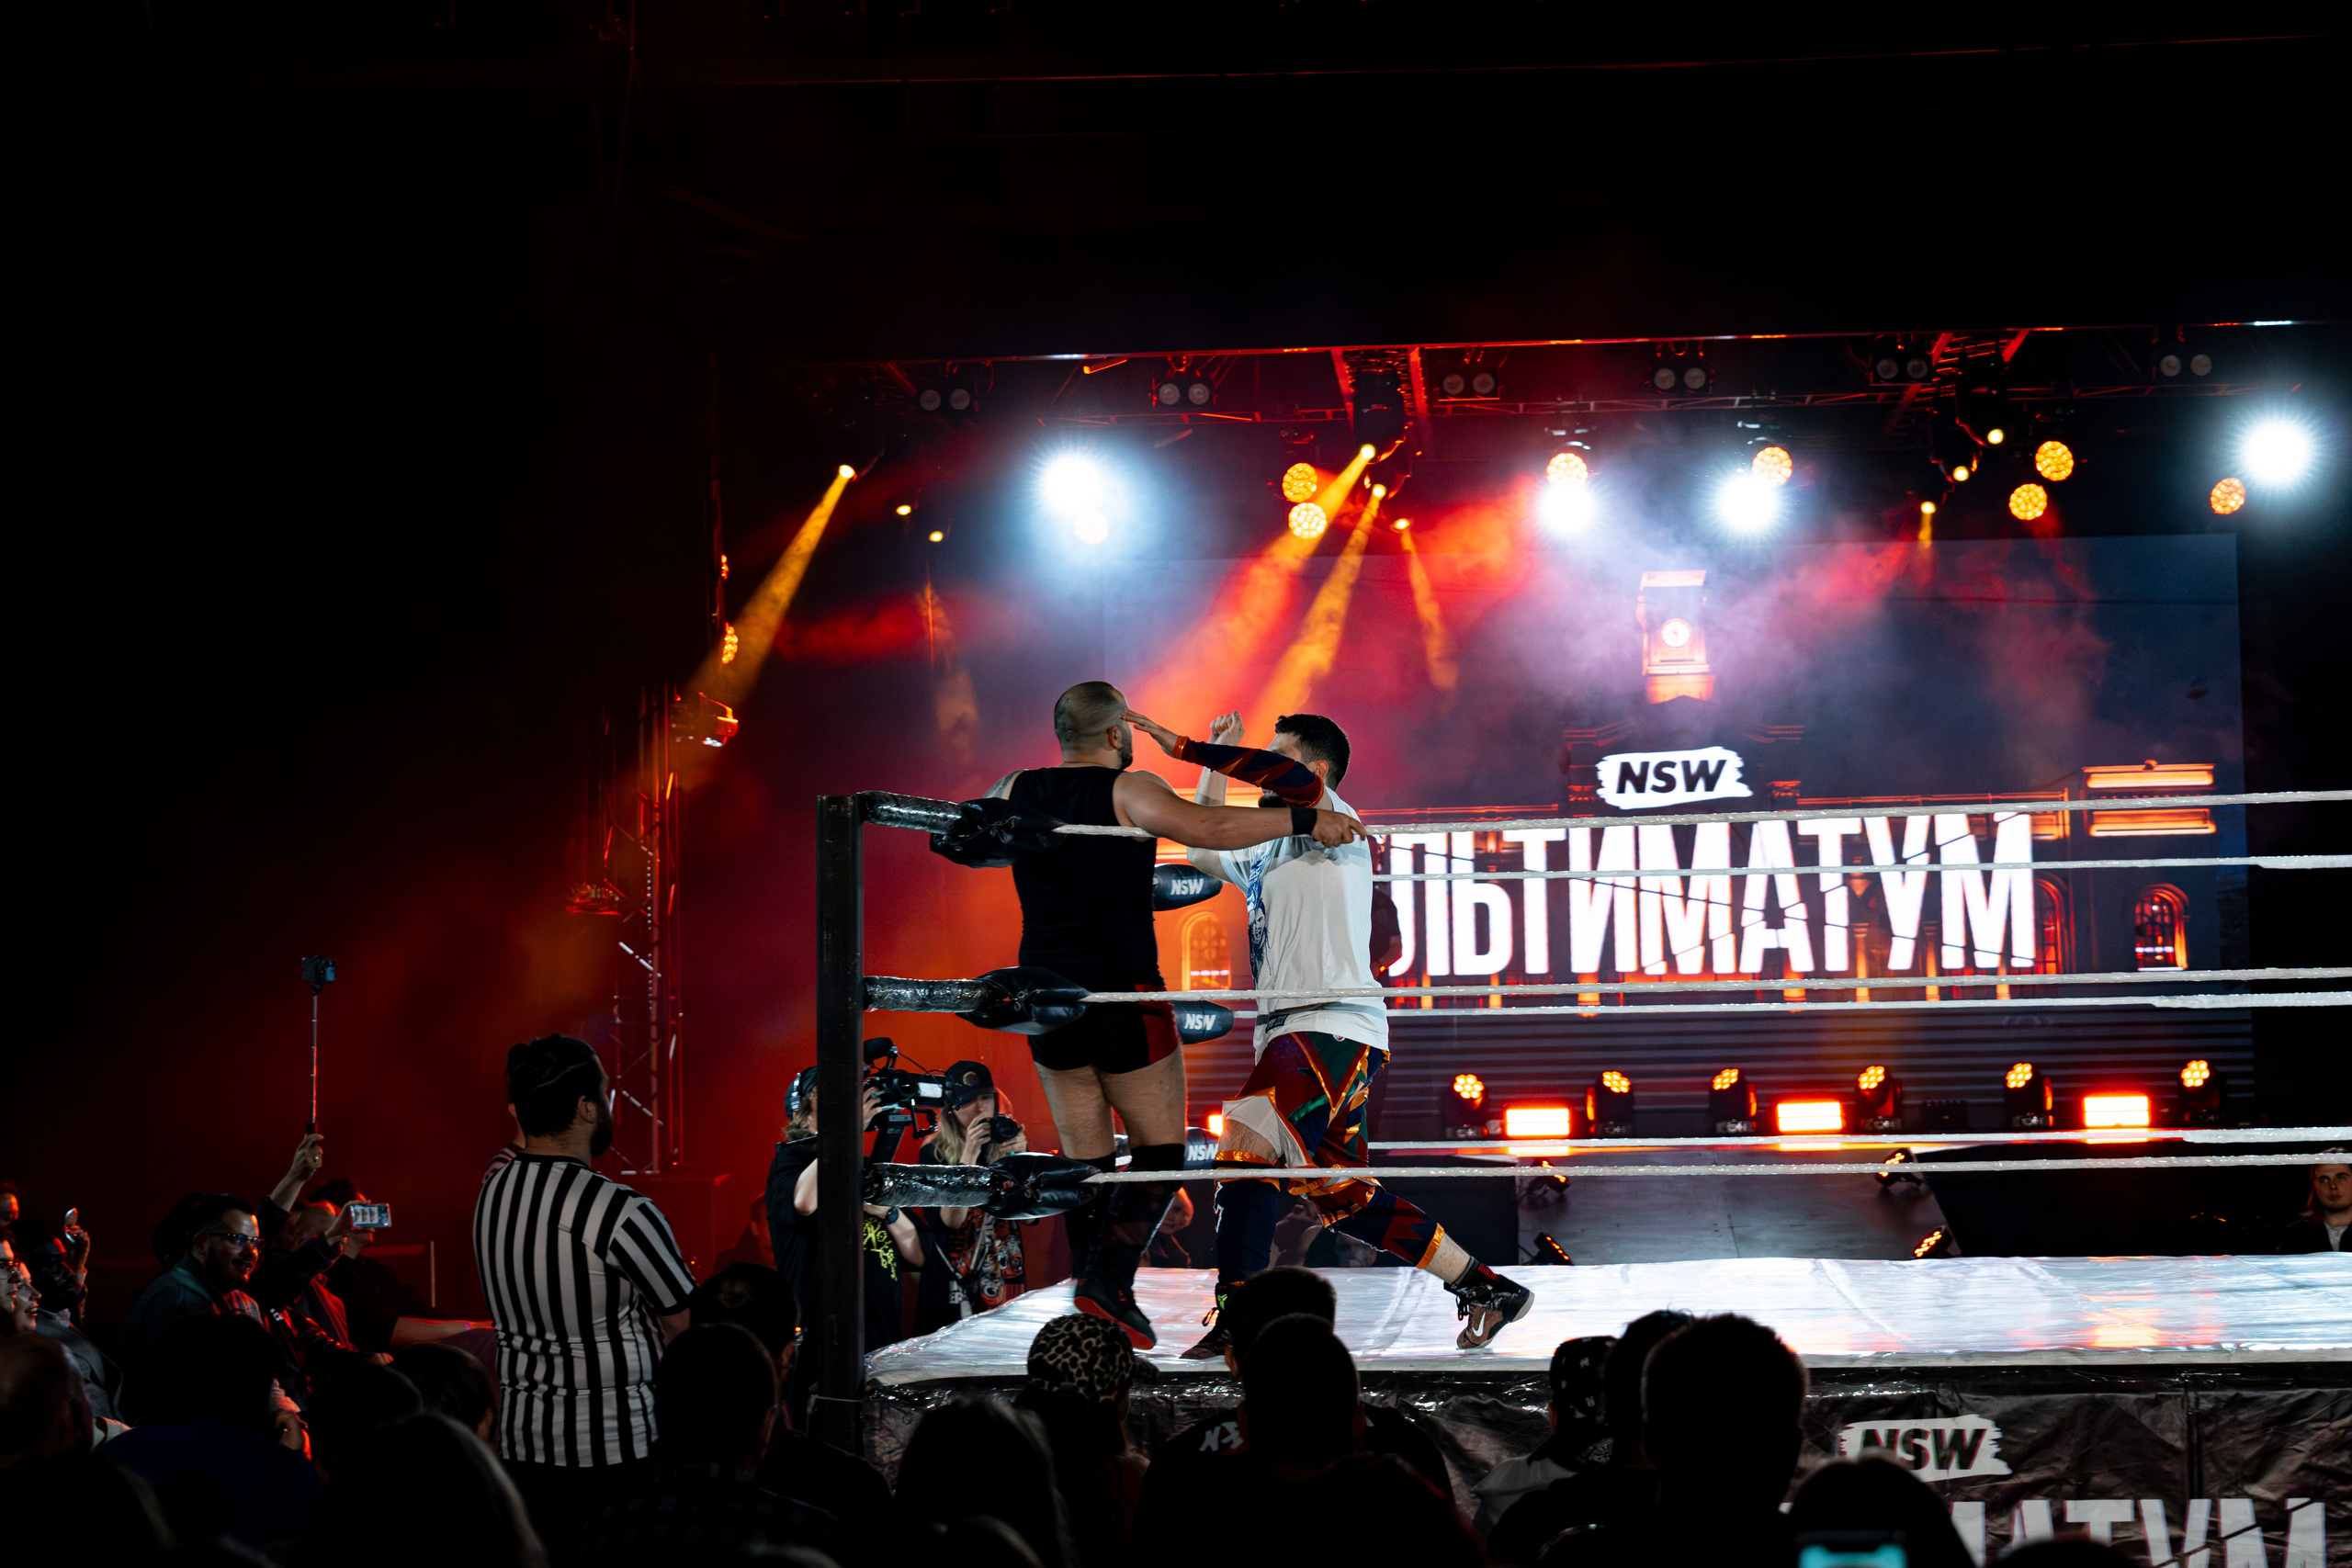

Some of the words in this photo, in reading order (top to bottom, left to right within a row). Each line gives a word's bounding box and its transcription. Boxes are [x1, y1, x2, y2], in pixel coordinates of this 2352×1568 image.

[1616, 759, 1727, 794] NSW
[1170, 878, 1204, 896] NSW
[1377, 811, 2036, 977] ЛЬТИМАТУМ
[1183, 1013, 1217, 1031] NSW
[1187, 1143, 1218, 1161] NSW
